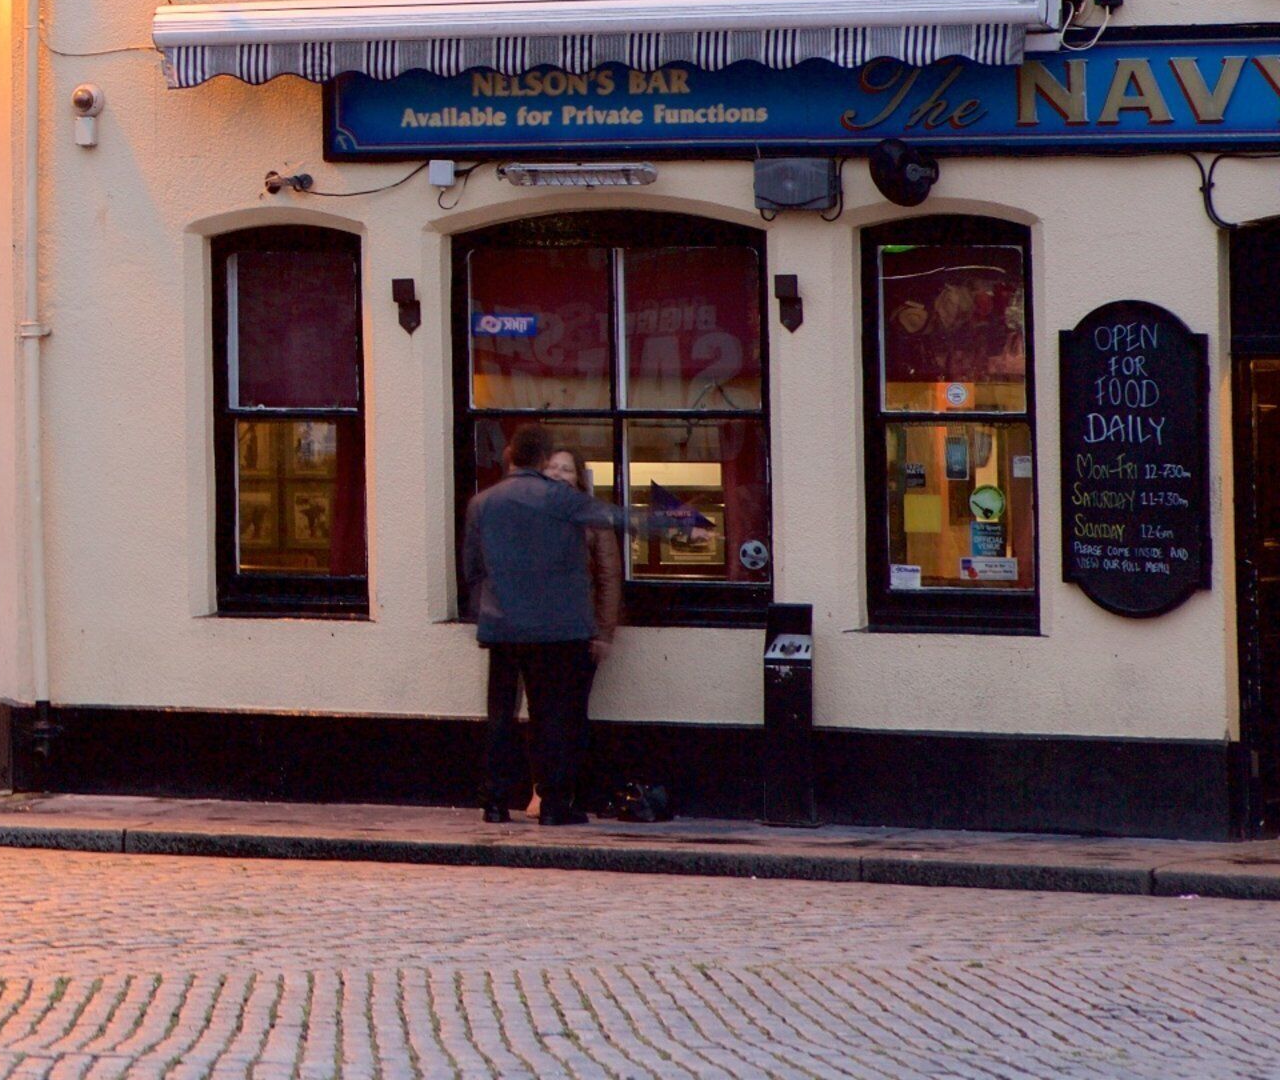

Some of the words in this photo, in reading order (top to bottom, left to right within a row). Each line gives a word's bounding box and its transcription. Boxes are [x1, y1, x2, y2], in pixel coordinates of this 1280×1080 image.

[472, 70, 614, 97] NELSON'S
[629, 68, 690, 95] BAR
[401, 106, 506, 128] Available
[517, 105, 552, 126] for
[562, 104, 643, 126] Private
[654, 102, 768, 123] Functions
[1094, 323, 1158, 352] OPEN
[1108, 355, 1148, 377] FOR
[1095, 375, 1160, 409] FOOD
[1083, 412, 1165, 446] DAILY
